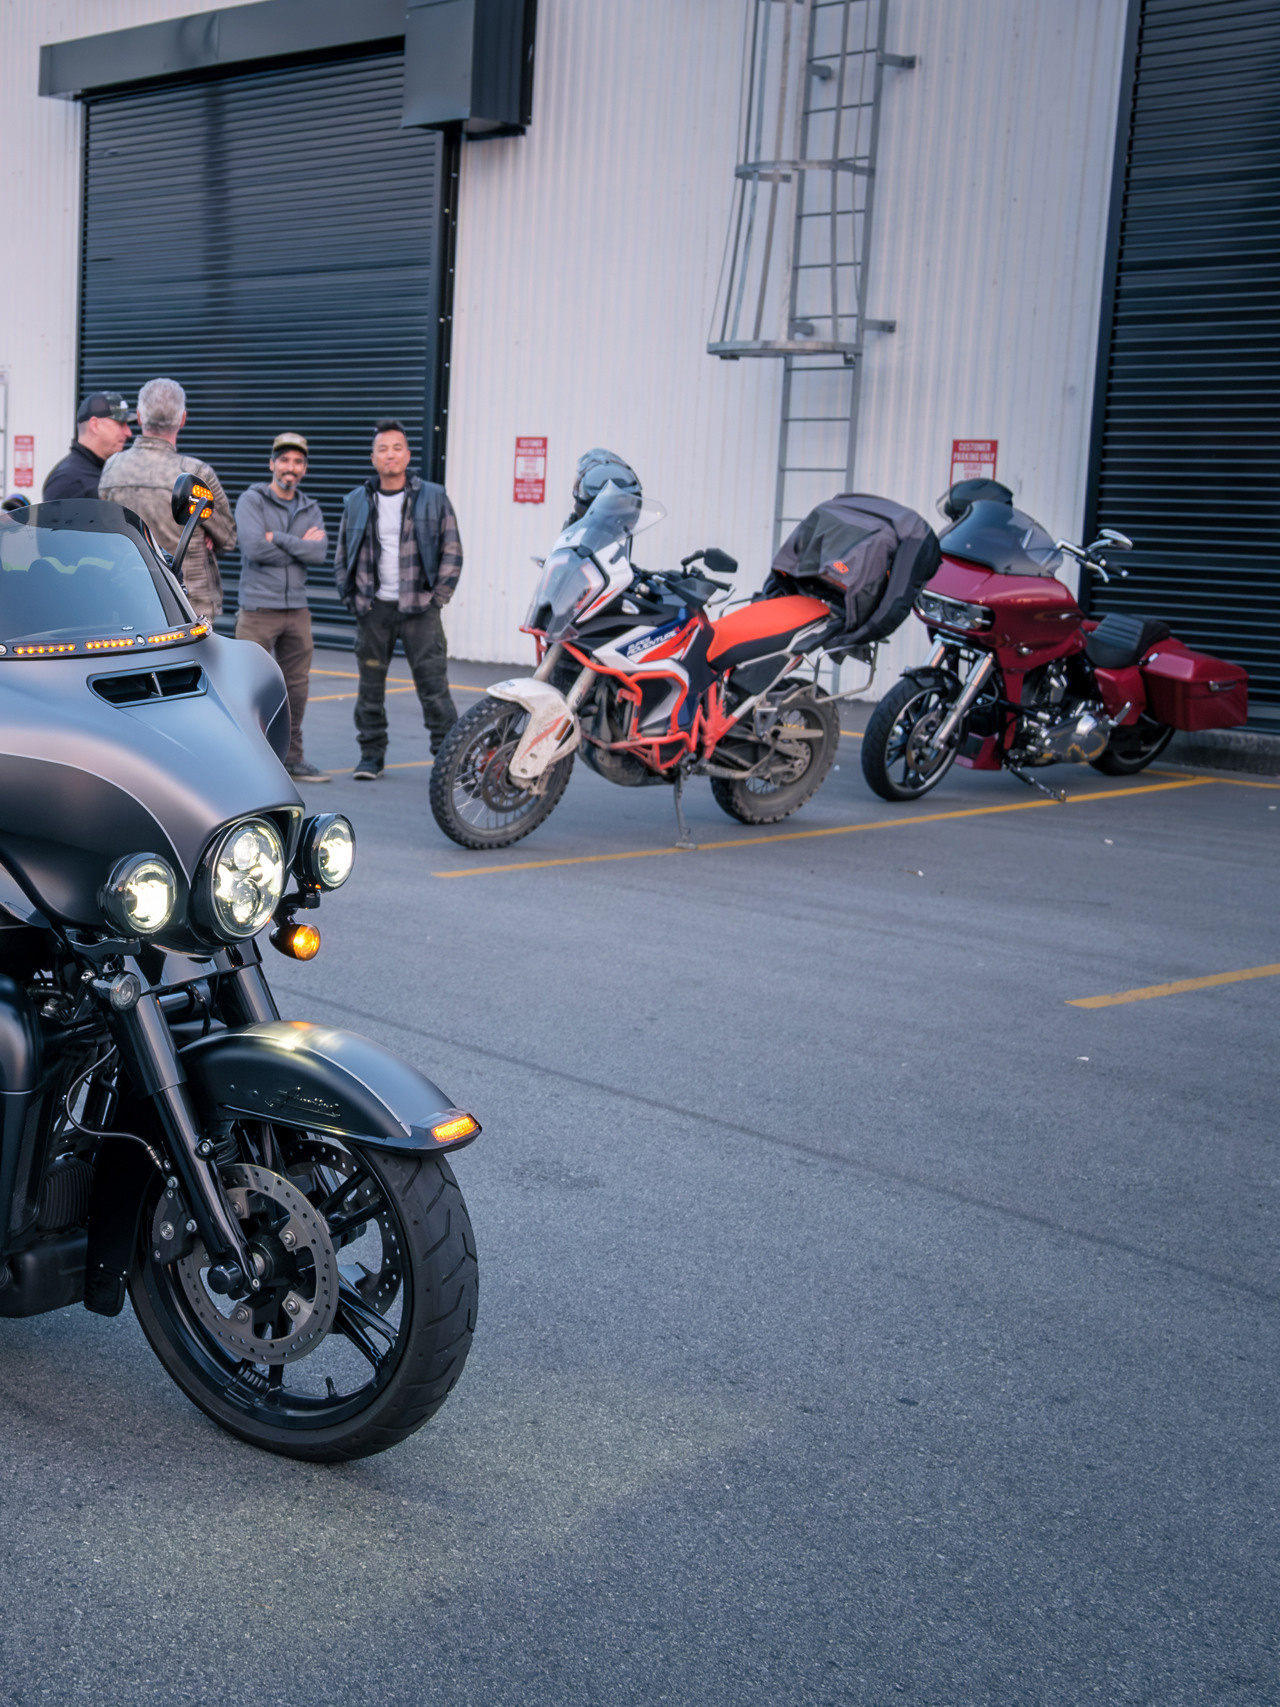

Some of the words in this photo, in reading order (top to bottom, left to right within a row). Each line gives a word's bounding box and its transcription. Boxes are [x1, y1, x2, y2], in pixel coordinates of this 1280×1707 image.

[958, 442, 991, 451] CUSTOMER
[953, 452, 979, 461] PARKING
[980, 452, 995, 462] ONLY
